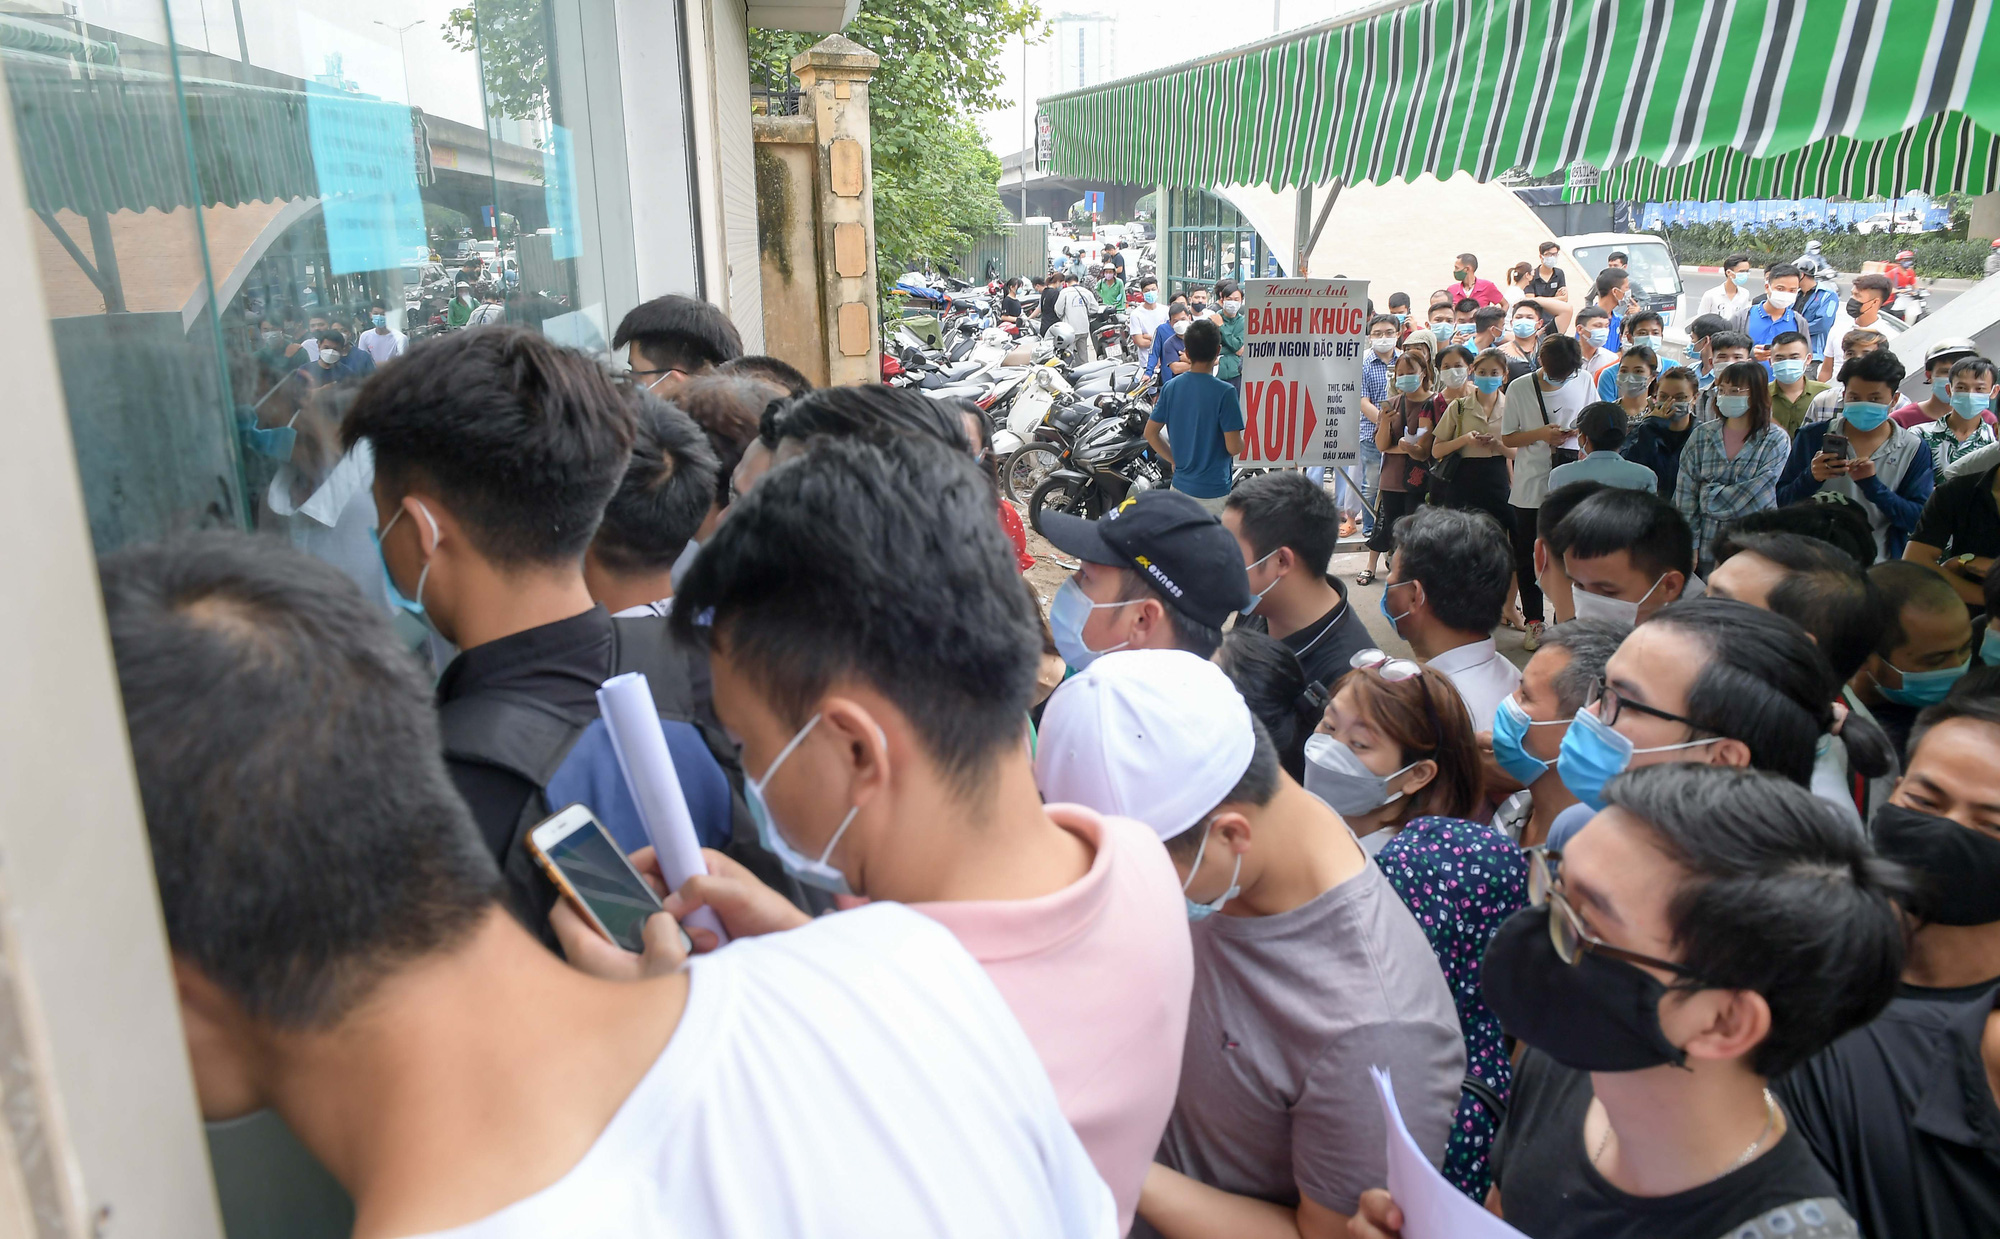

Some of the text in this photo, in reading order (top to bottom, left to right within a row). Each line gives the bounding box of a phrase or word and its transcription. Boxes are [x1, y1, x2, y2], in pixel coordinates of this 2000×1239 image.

[1265, 284, 1348, 297] Hương Anh
[1247, 302, 1363, 335] BÁNH KHÚC
[1247, 338, 1360, 361] THƠM NGON ĐẶC BIỆT
[1341, 381, 1355, 392] CHẢ
[1239, 362, 1299, 462] XÔI
[1322, 450, 1356, 462] ĐẬU XANH
[1148, 564, 1183, 598] exness
